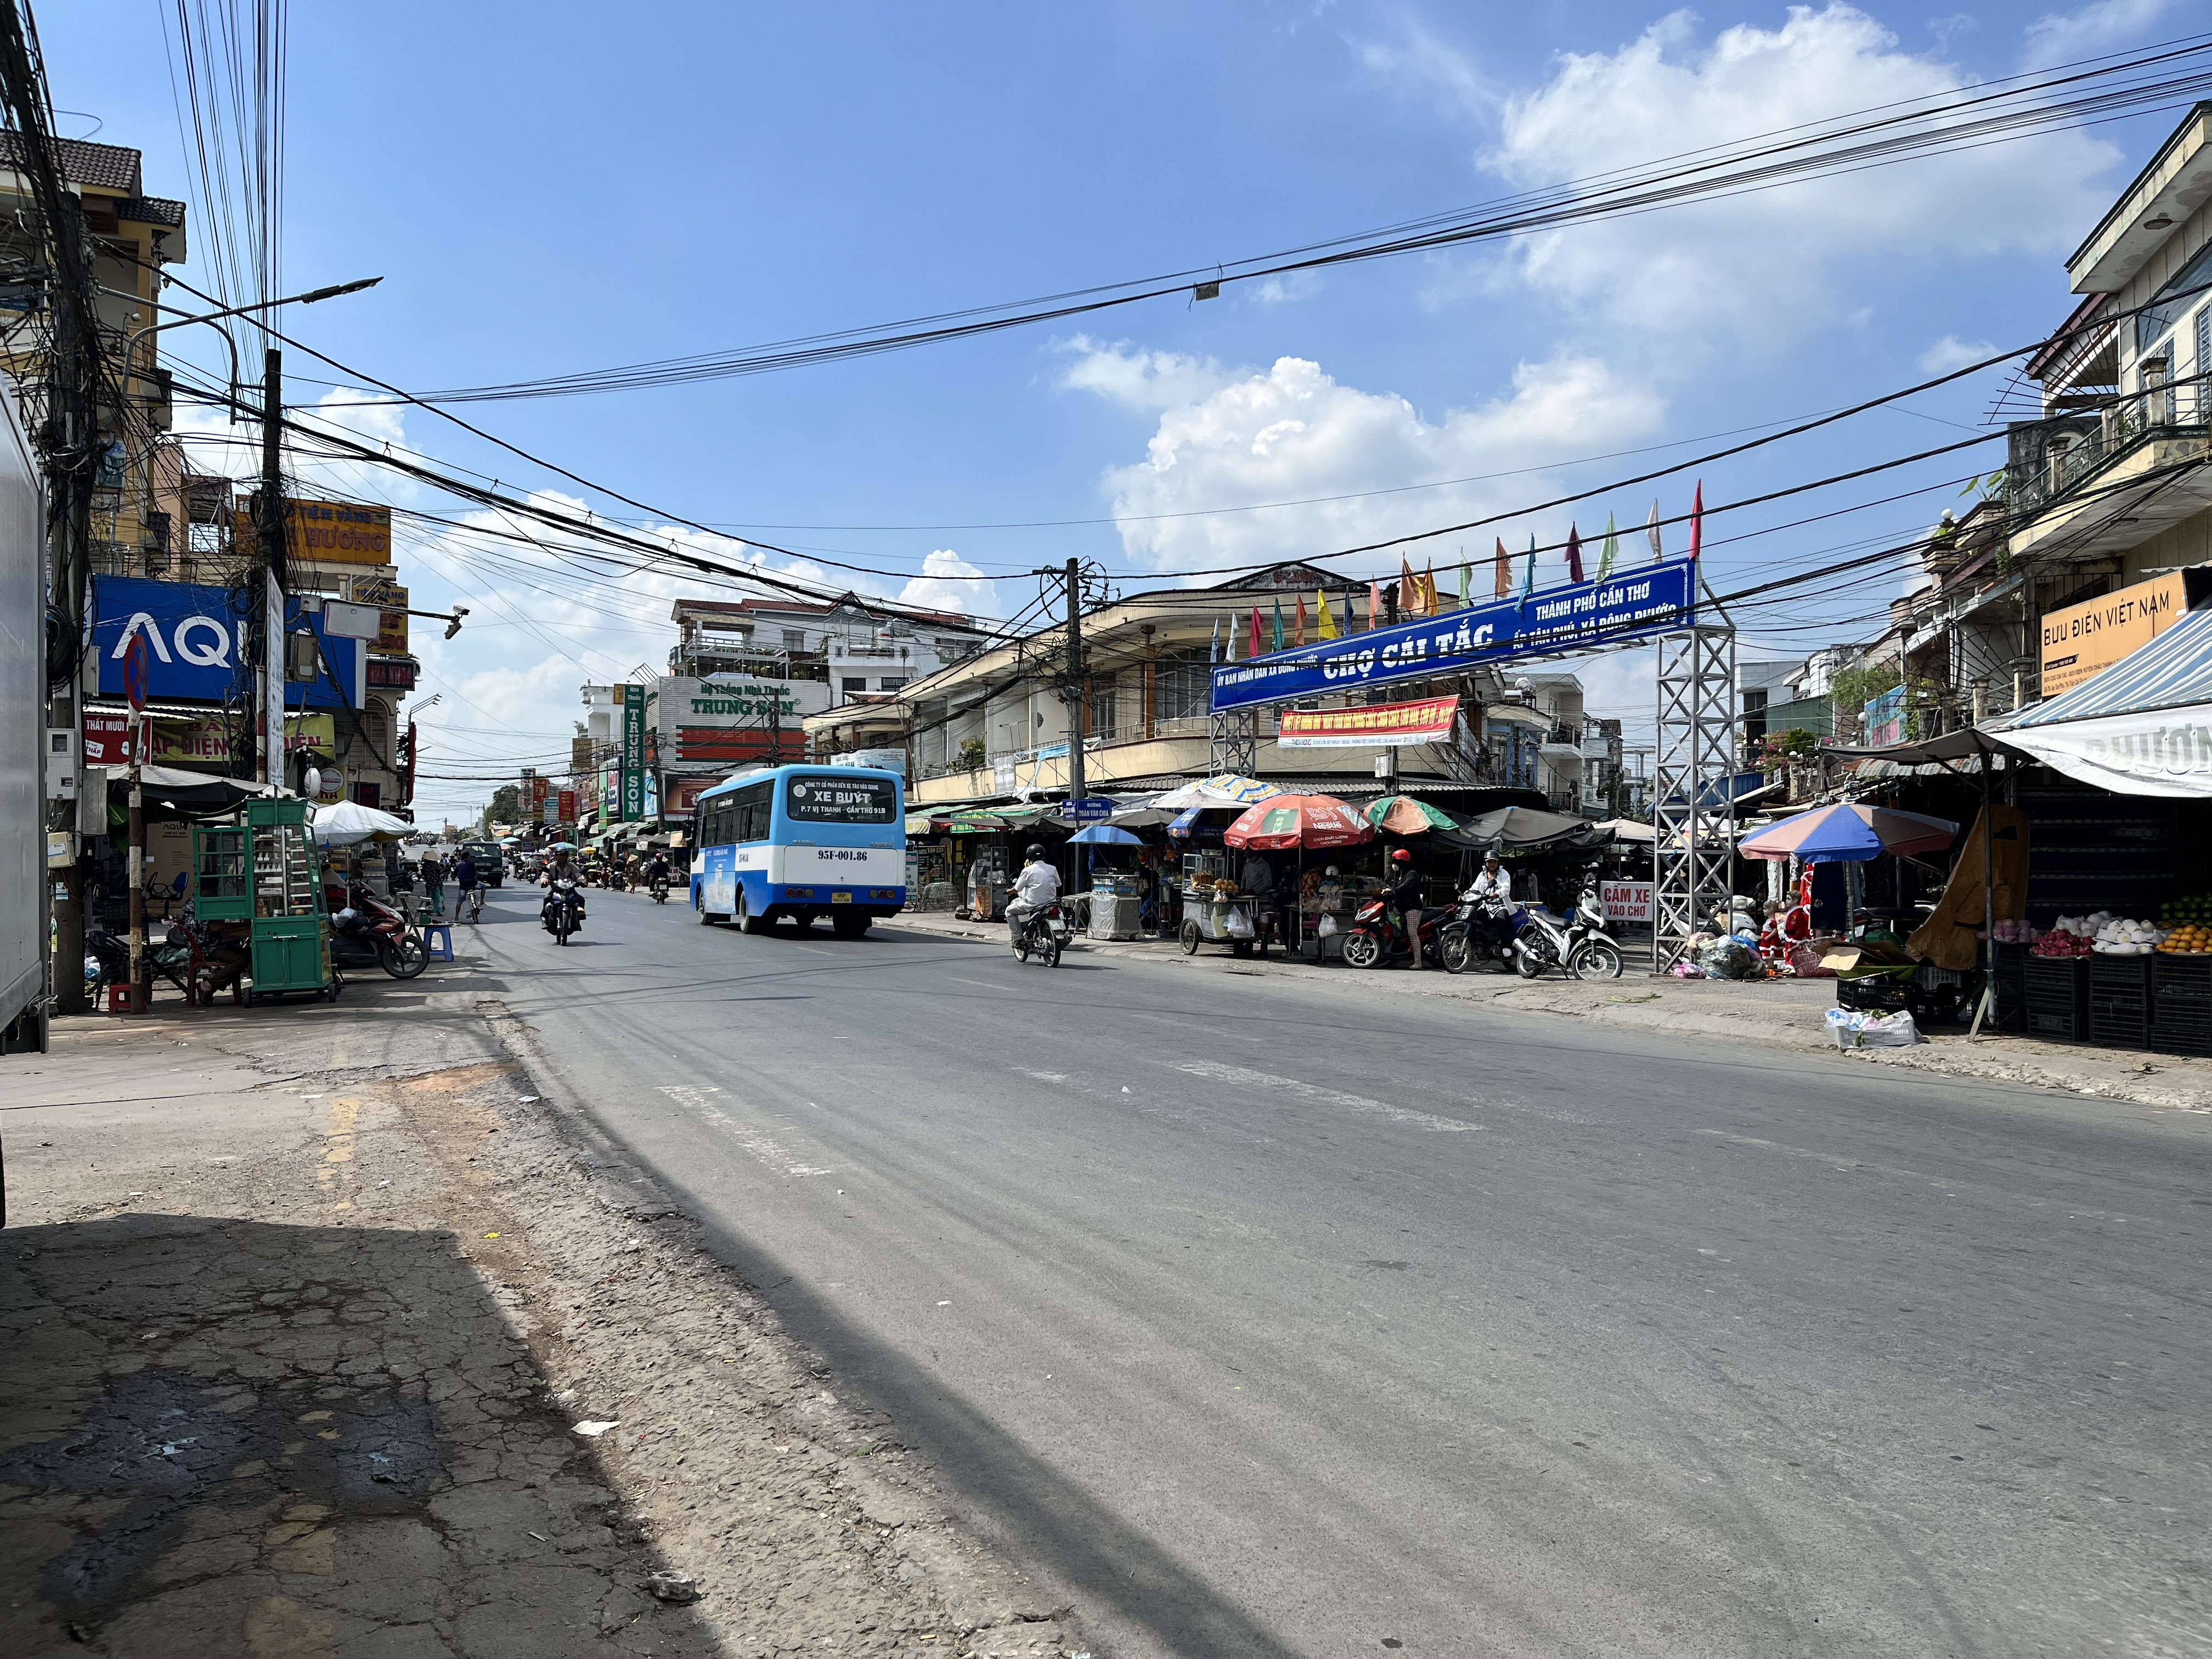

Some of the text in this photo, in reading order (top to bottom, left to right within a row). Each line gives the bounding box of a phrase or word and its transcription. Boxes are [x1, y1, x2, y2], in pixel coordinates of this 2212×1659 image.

[305, 525, 385, 551] HƯƠNG
[1536, 580, 1650, 621] THÀNH PHỐ CẦN THƠ
[2044, 590, 2169, 646] BƯU ĐIỆN VIỆT NAM
[1323, 618, 1493, 679] CHỢ CÁI TẮC
[1225, 672, 1236, 685] BAN
[1238, 668, 1254, 683] NHÂN
[764, 684, 790, 695] Thốc
[691, 698, 752, 715] TRUNG
[86, 717, 104, 731] THẤT
[629, 709, 640, 770] TRUNG
[797, 786, 803, 795] 2
[814, 791, 871, 804] XE BUÝT
[1313, 821, 1342, 830] Nestlé
[818, 850, 867, 861] 95F-001.86
[1635, 889, 1650, 903] XE
[1608, 902, 1646, 919] VÀO CHỢ
